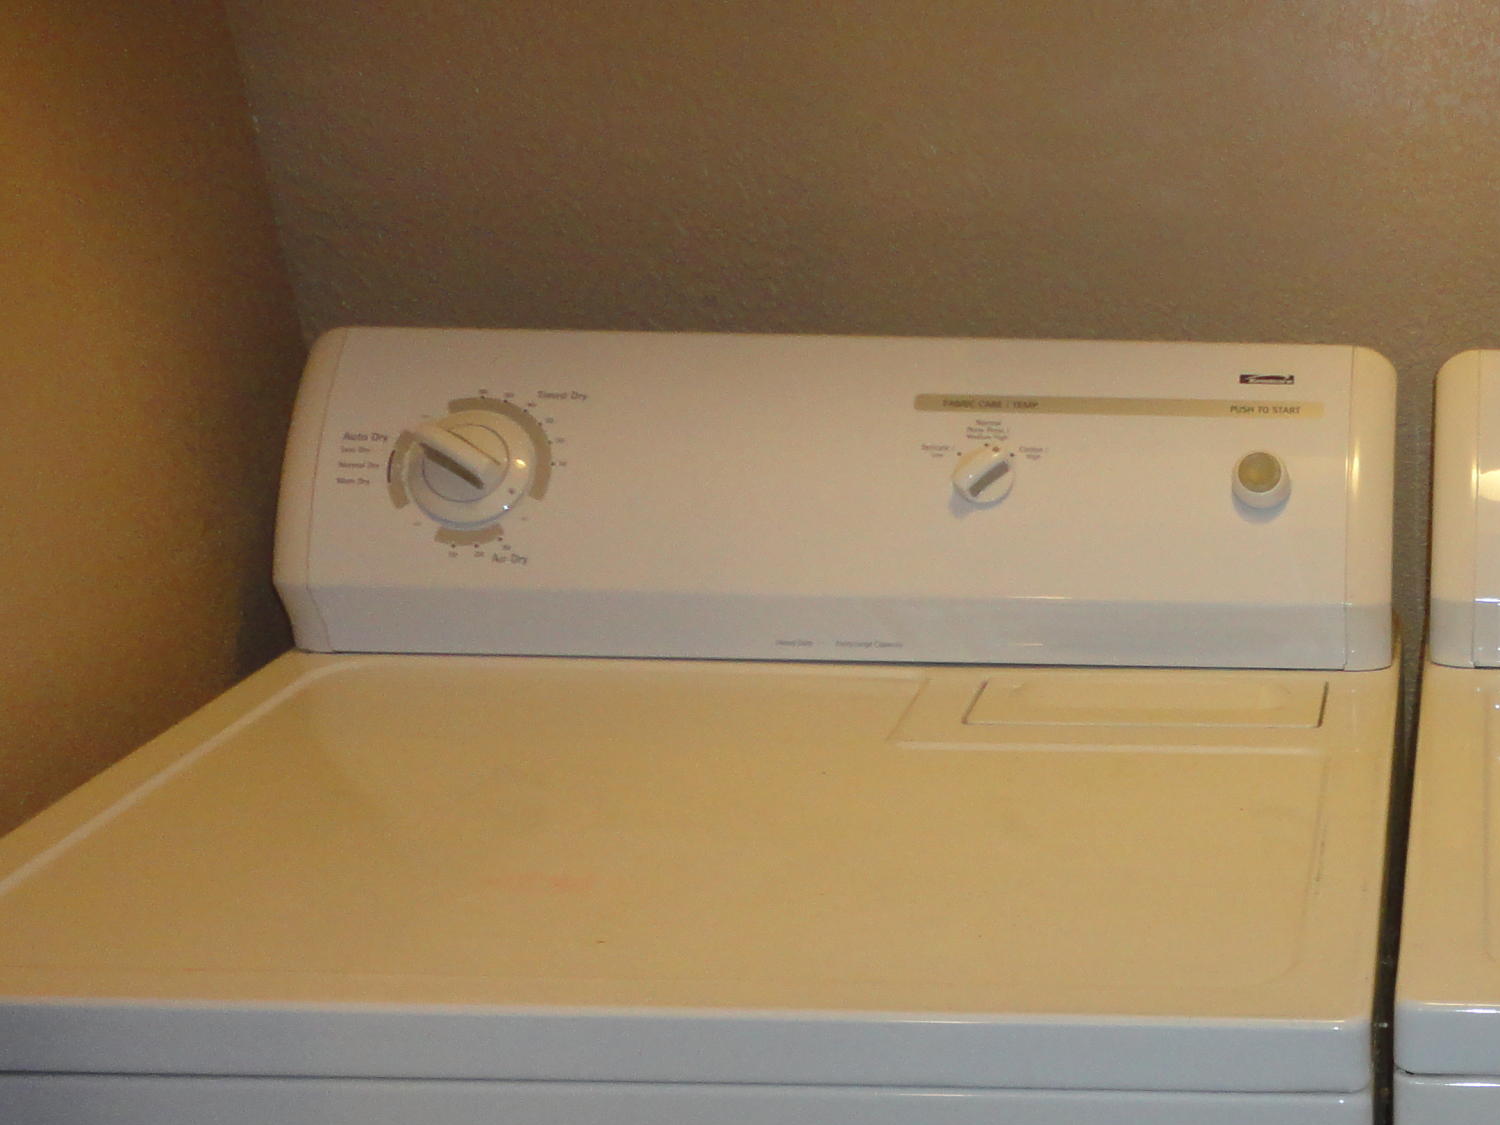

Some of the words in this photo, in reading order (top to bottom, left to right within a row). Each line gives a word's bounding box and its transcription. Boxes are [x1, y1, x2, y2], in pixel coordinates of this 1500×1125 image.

[1229, 405, 1255, 414] PUSH
[1257, 406, 1269, 415] TO
[1272, 406, 1301, 415] START
[343, 431, 368, 442] Auto
[371, 432, 388, 444] Dry
[510, 553, 528, 566] Dry
